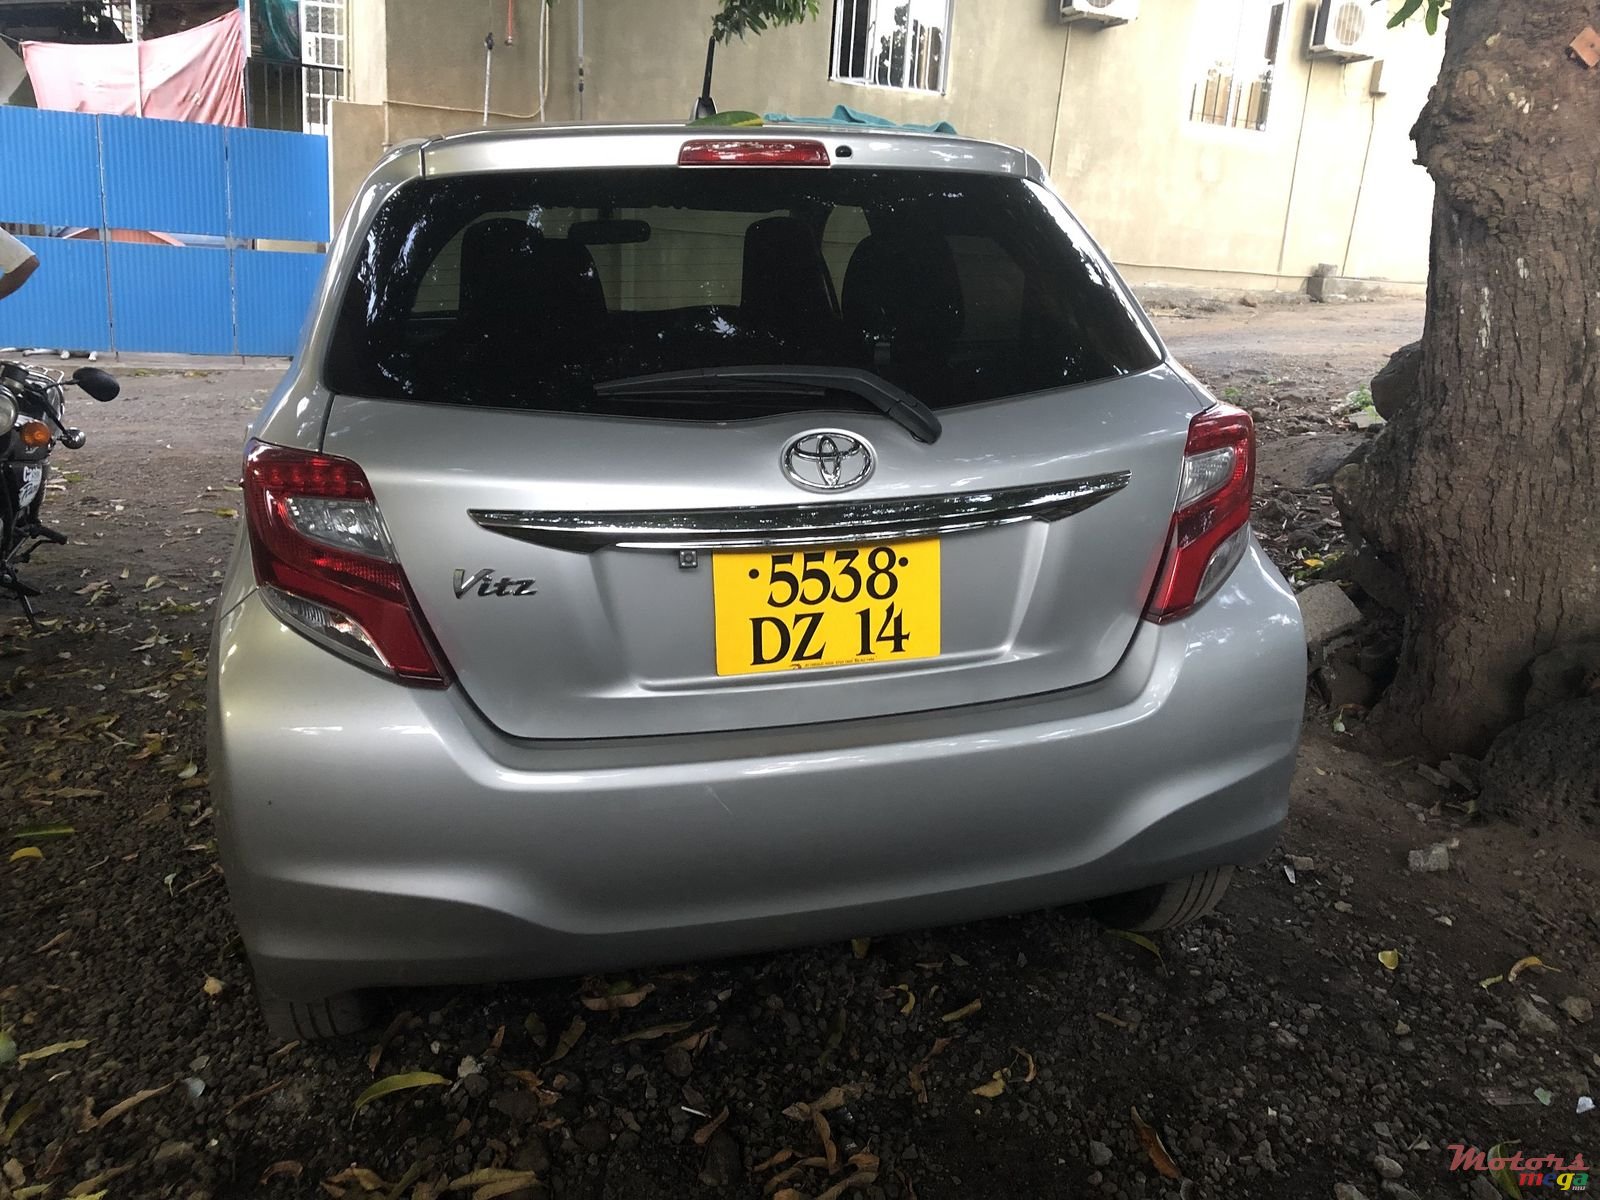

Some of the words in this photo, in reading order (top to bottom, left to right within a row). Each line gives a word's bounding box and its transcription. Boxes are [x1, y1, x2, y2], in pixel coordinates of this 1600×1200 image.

[453, 568, 538, 599] Vitz
[767, 546, 898, 608] 5538
[749, 612, 826, 666] DZ
[856, 601, 910, 656] 14
